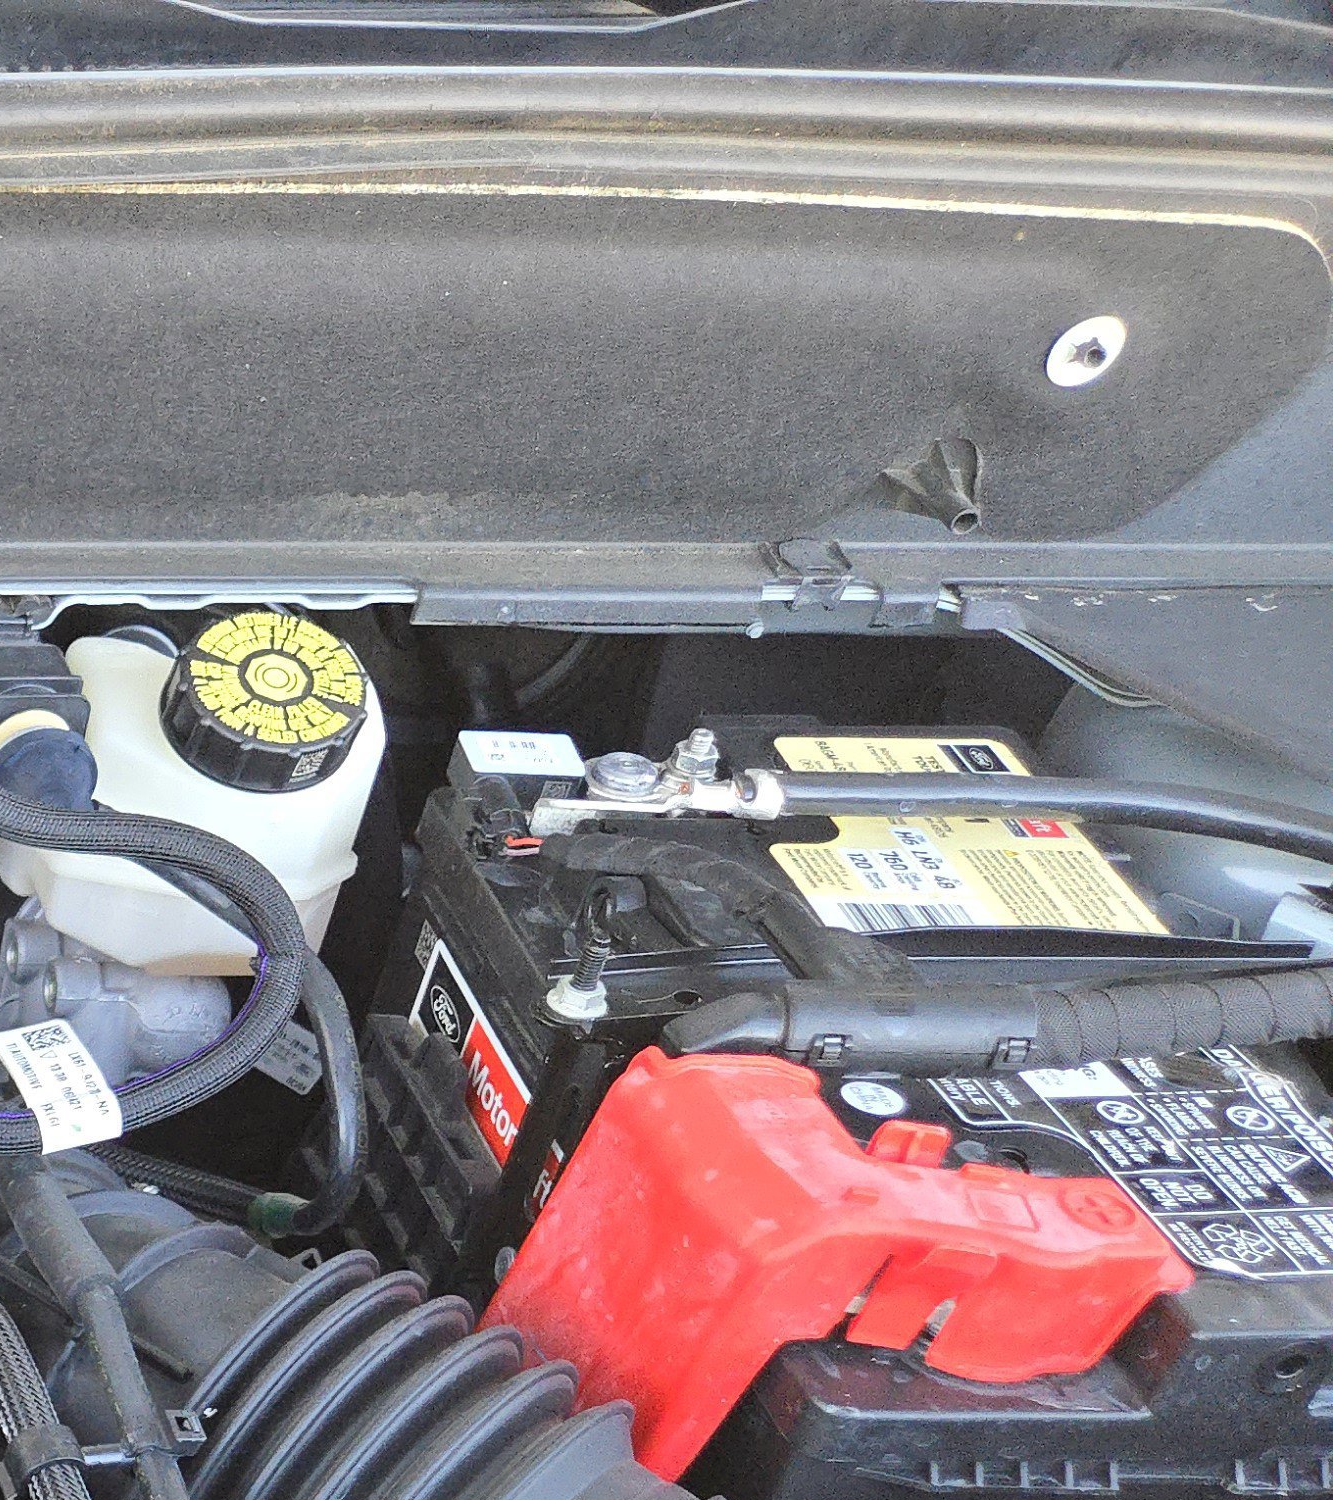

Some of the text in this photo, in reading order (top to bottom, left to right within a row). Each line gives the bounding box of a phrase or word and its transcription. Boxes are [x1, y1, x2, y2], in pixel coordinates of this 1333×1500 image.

[845, 853, 874, 869] 120
[876, 850, 910, 870] 760
[893, 831, 921, 845] H6
[910, 850, 941, 869] LN3
[930, 875, 957, 888] 48
[431, 992, 458, 1038] Ford
[1161, 1179, 1197, 1208] NOT
[1183, 1180, 1215, 1204] DO
